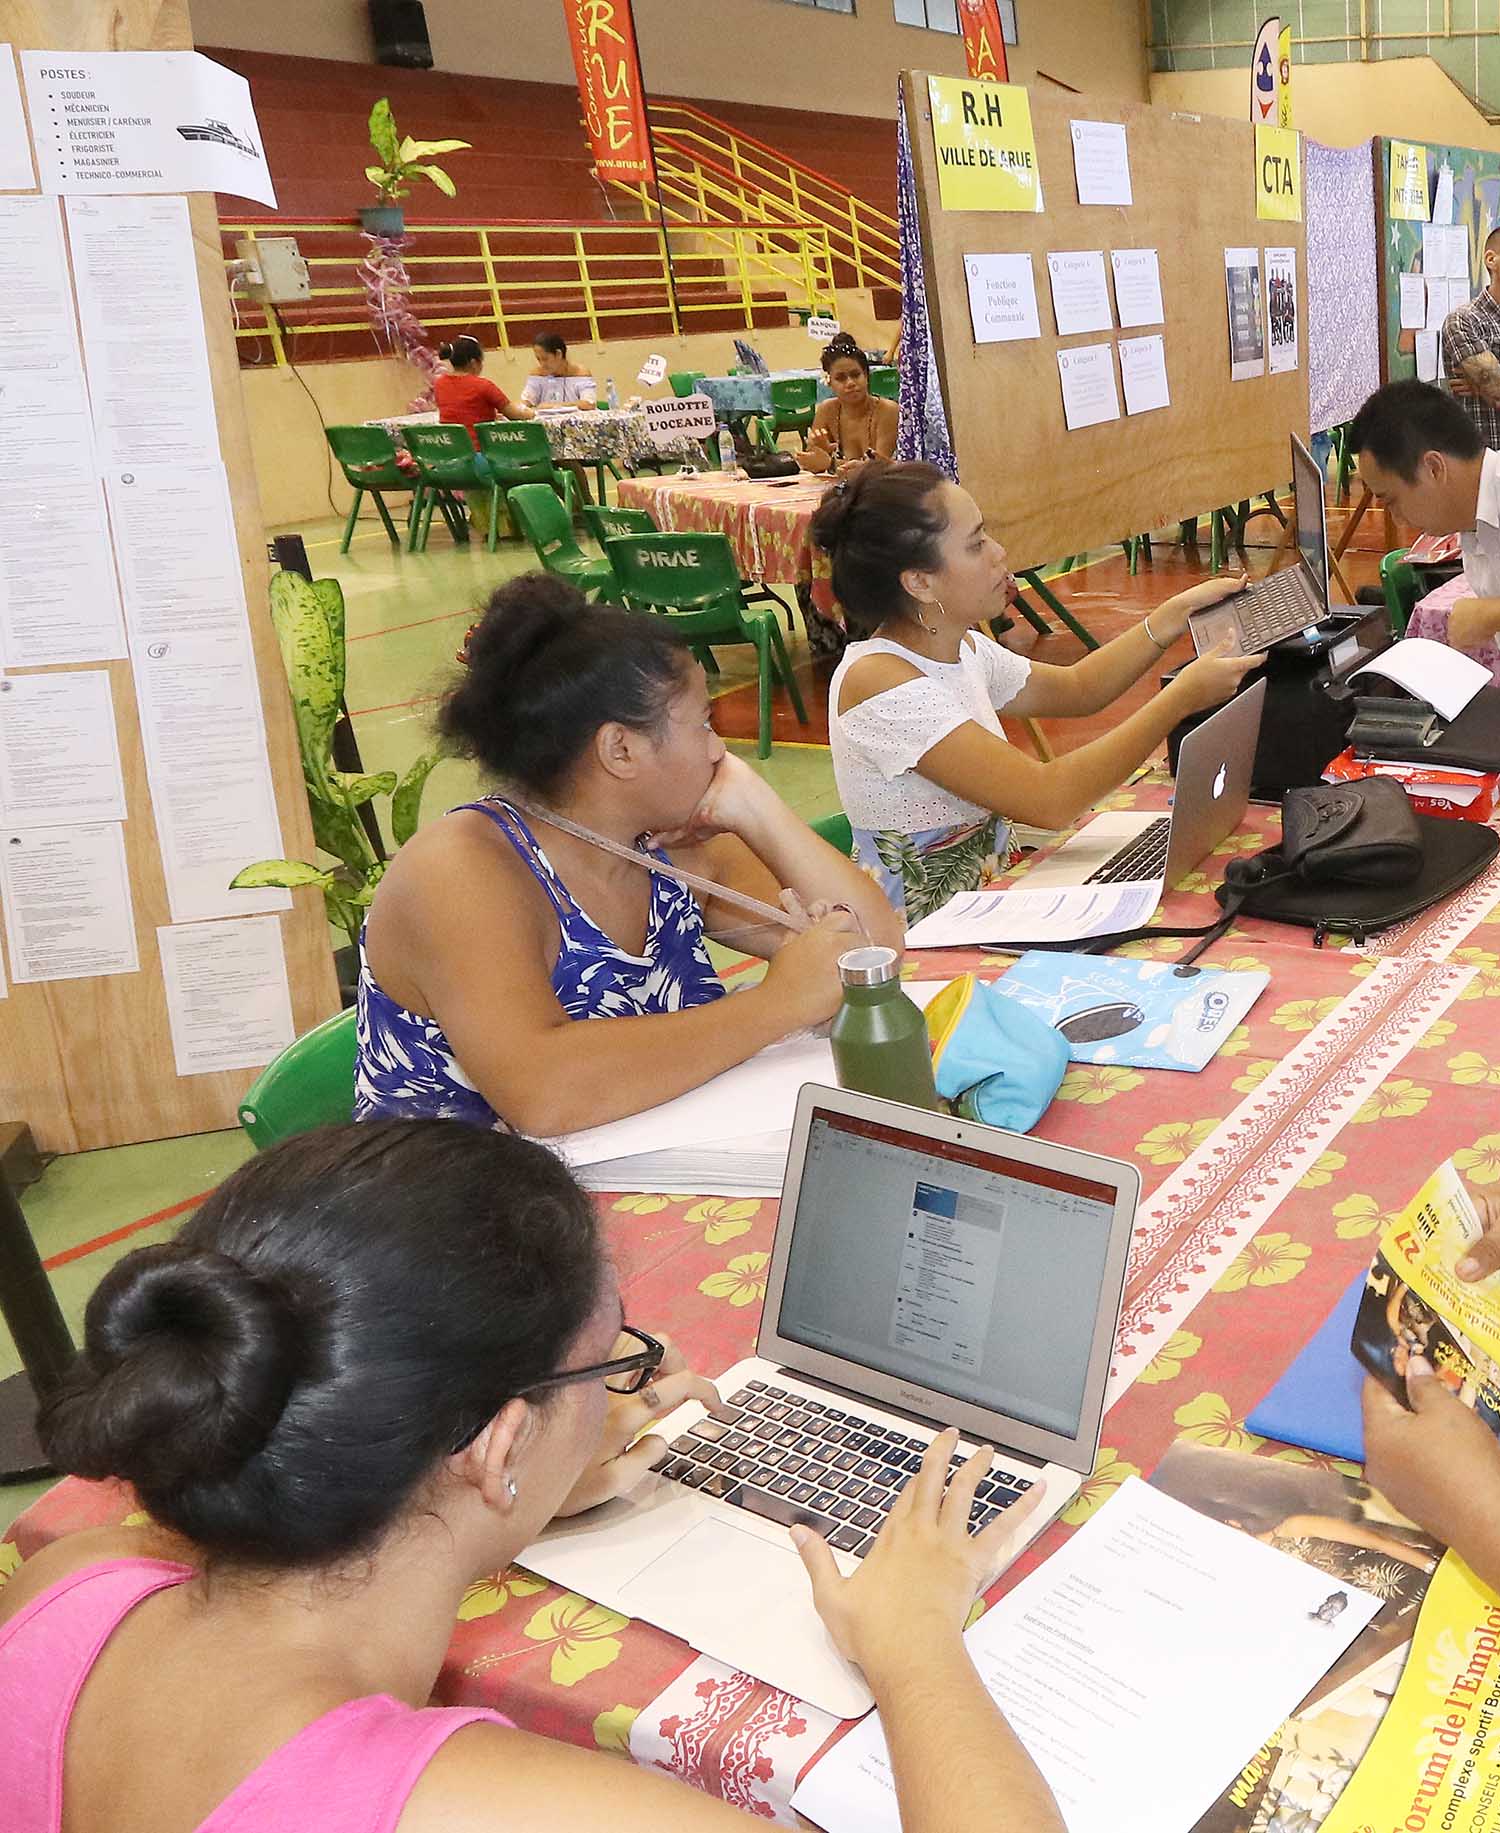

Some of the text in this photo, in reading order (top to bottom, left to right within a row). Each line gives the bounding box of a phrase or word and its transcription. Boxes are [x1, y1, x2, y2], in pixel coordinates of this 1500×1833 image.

[40, 69, 86, 80] POSTES
[60, 91, 96, 100] SOUDEUR
[64, 104, 110, 113] MÉCANICIEN
[961, 91, 1003, 127] R.H
[66, 118, 107, 127] MENUISIER
[69, 130, 116, 139] ÉLECTRICIEN
[71, 145, 115, 153] FRIGORISTE
[940, 147, 1032, 169] VILLE DE ARUE
[73, 158, 120, 166] MAGASINIER
[75, 170, 164, 179] TECHNICO-COMMERCIAL
[1262, 154, 1294, 196] CTA
[646, 400, 710, 415] ROULOTTE
[649, 416, 714, 432] L'OCEANE
[637, 549, 701, 568] PIRAE
[1196, 991, 1230, 1033] OREO
[1424, 1203, 1441, 1226] 2019
[1416, 1211, 1436, 1242] juin
[1393, 1231, 1421, 1265] 27
[1432, 1713, 1466, 1747] de
[1440, 1759, 1476, 1831] complexe
[1468, 1708, 1494, 1757] sportif
[1468, 1773, 1500, 1833] CONSEILS
